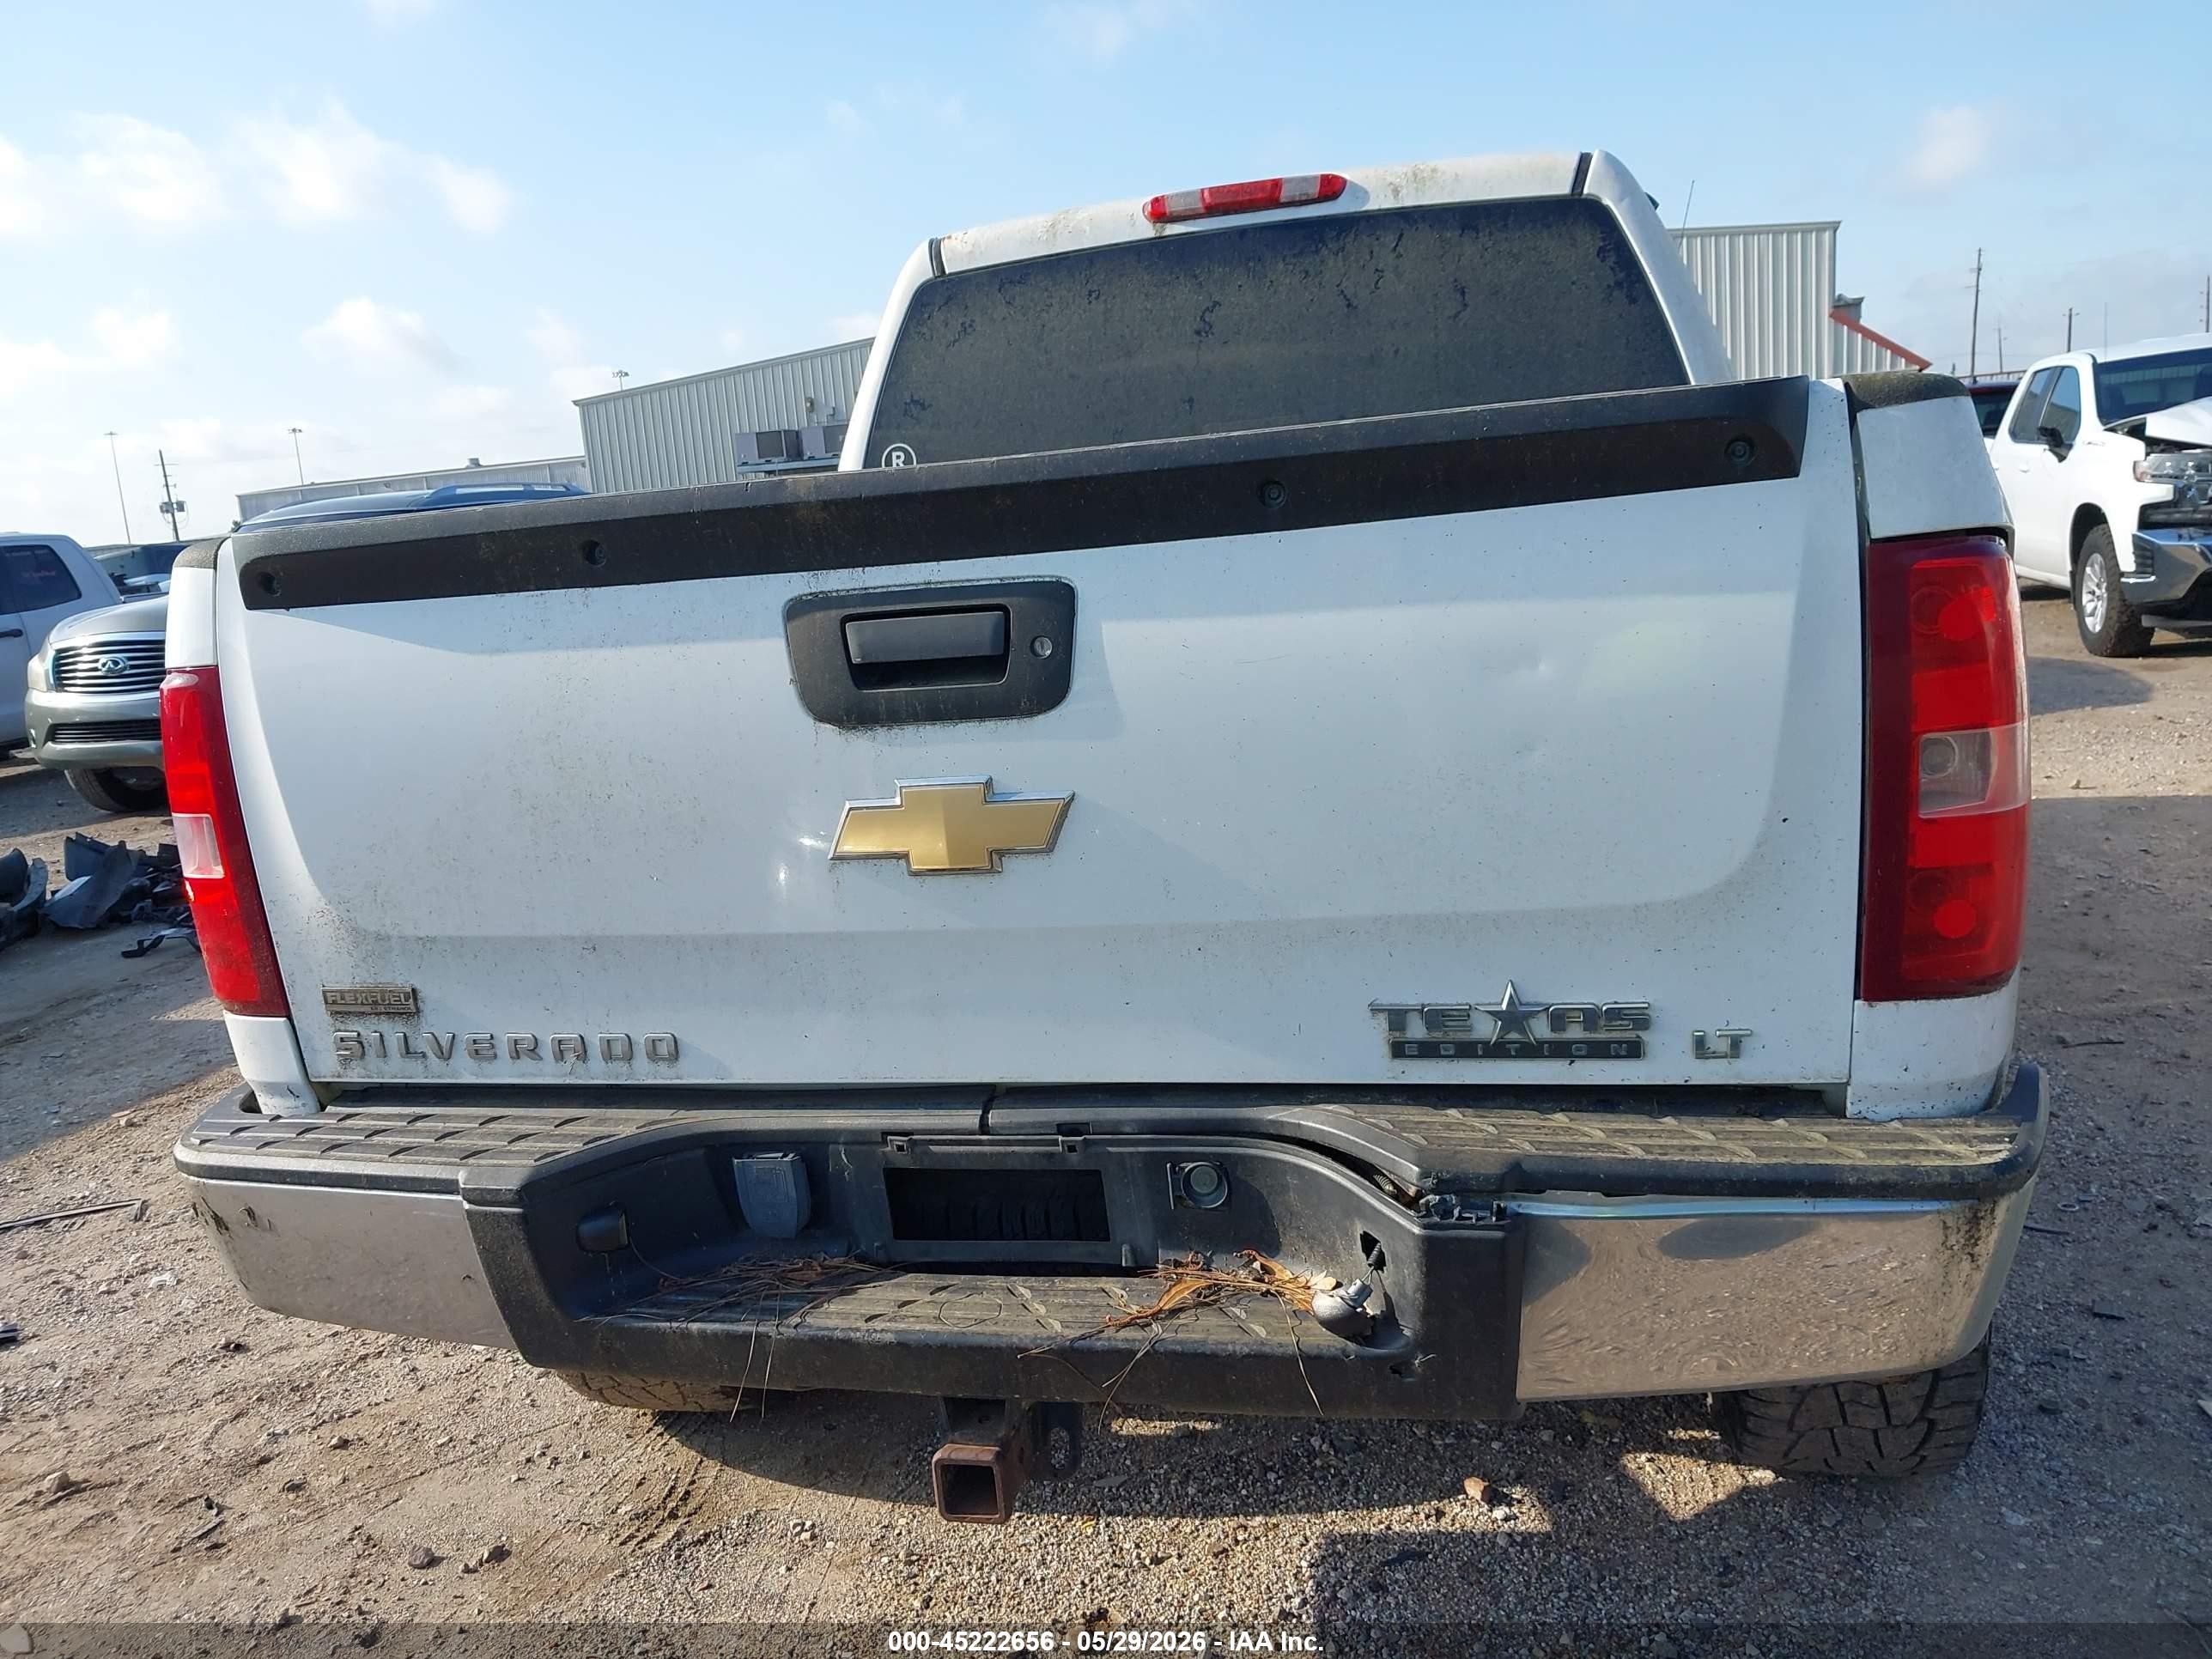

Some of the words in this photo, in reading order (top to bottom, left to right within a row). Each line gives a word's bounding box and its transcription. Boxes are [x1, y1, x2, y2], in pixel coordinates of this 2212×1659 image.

[331, 1030, 681, 1062] SILVERADO
[1404, 1042, 1628, 1056] EDITION
[1692, 1029, 1753, 1059] LT
